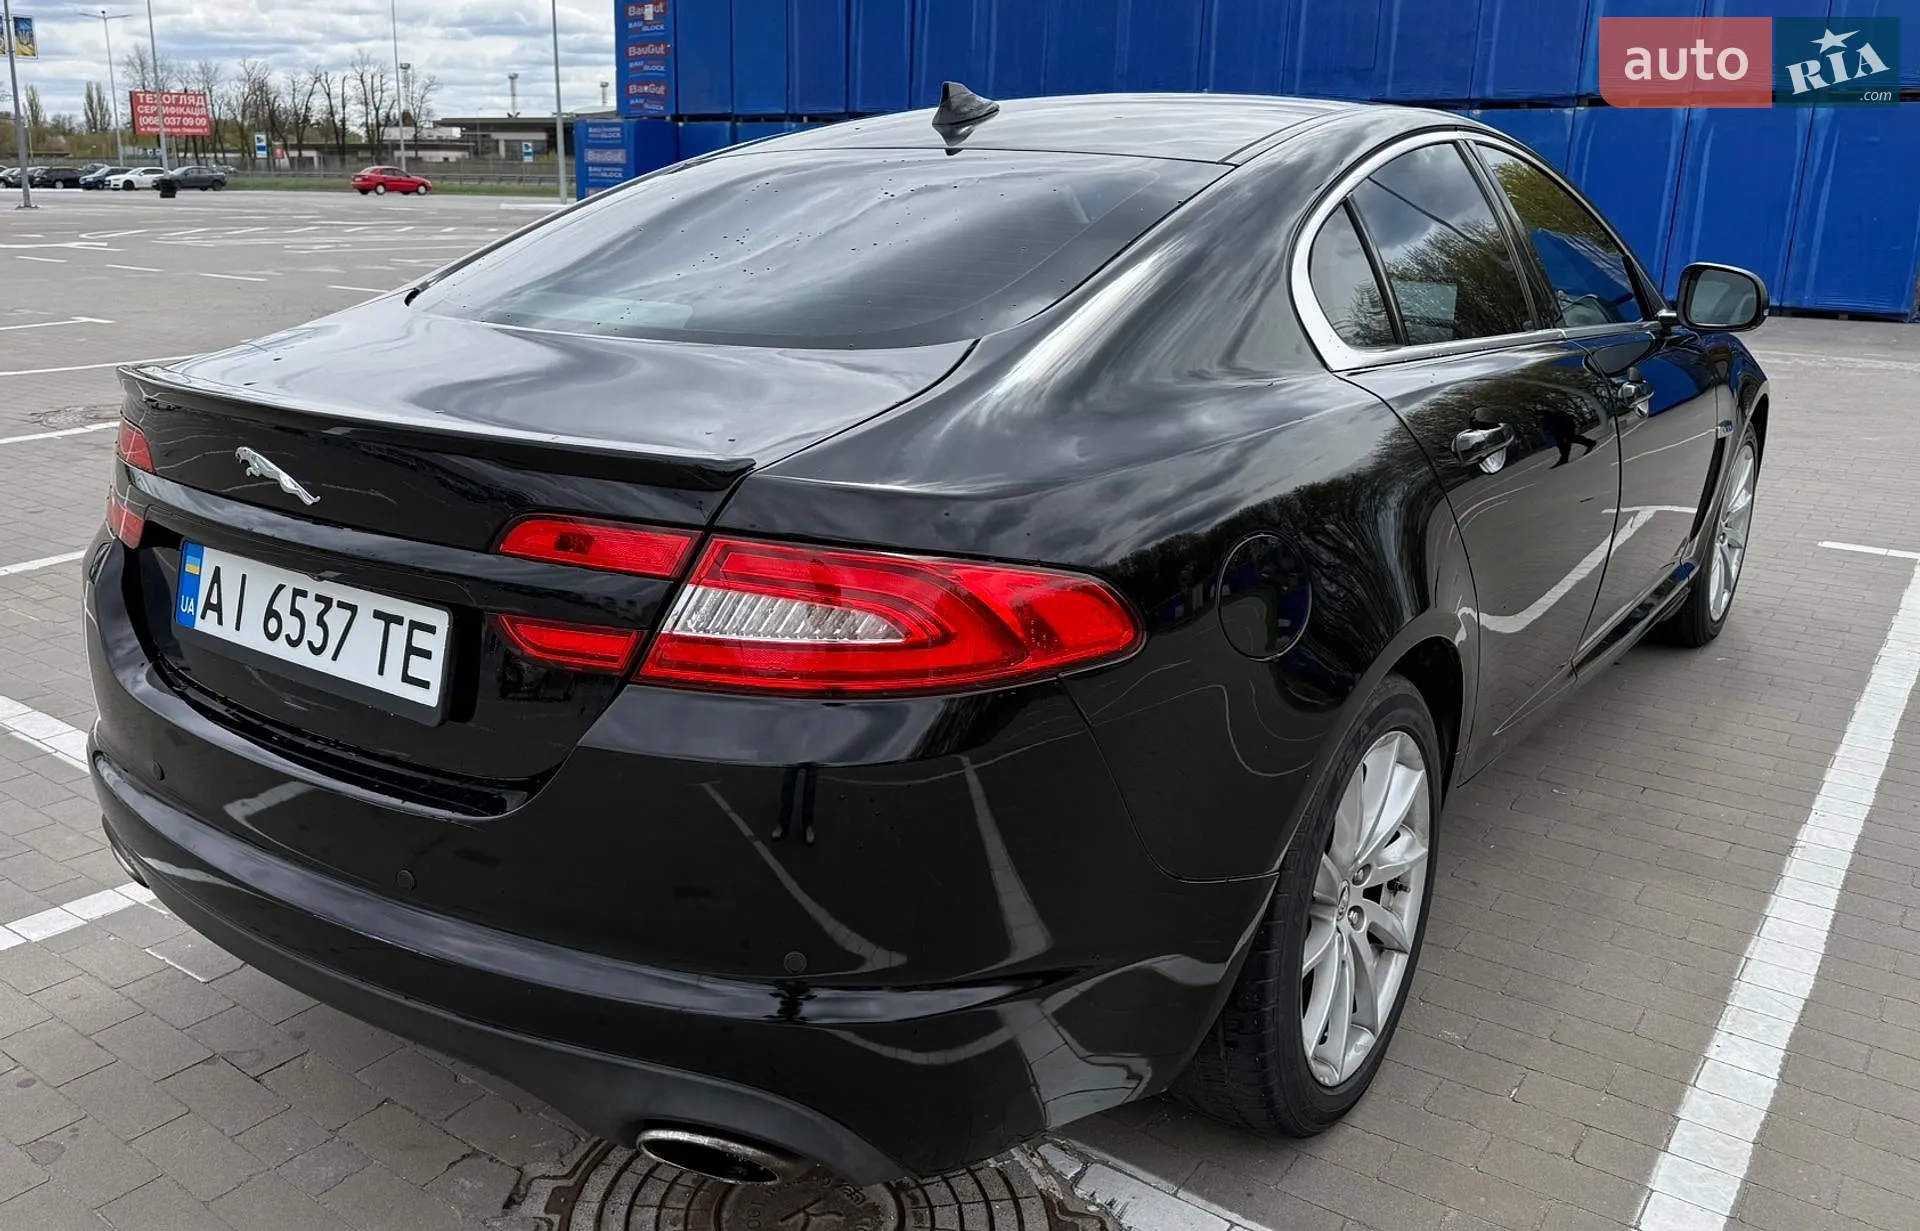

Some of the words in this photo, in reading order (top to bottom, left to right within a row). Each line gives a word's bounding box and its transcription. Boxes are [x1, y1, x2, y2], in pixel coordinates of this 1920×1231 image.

[628, 44, 665, 56] BauGut
[137, 105, 206, 116] СЕРИФІКАЦІЯ
[182, 117, 194, 127] 09
[195, 117, 207, 127] 09
[180, 595, 195, 615] UA
[200, 566, 247, 631] AI
[263, 583, 358, 662] 6537
[373, 609, 437, 690] TE
